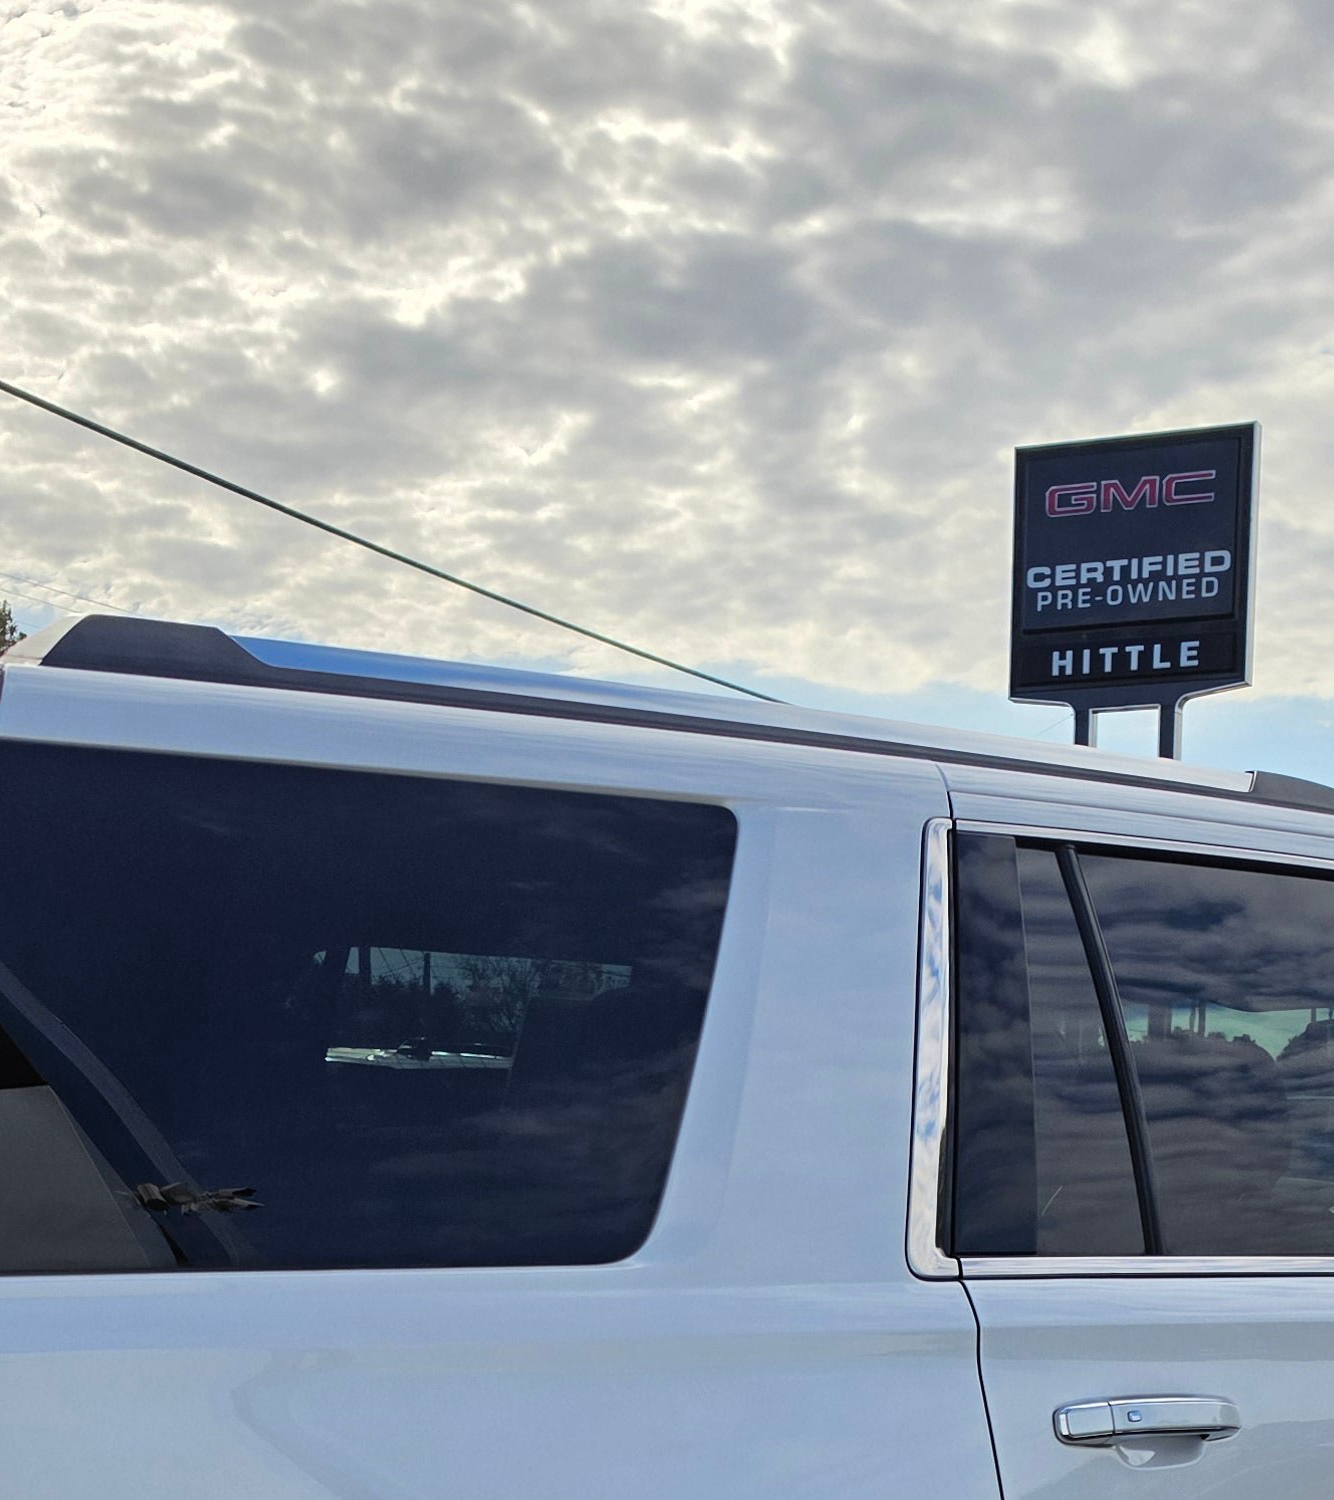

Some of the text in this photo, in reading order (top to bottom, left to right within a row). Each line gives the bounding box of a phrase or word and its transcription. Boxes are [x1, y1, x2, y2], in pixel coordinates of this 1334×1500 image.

[1045, 469, 1216, 517] GMC
[1026, 549, 1232, 588] CERTIFIED
[1036, 576, 1219, 612] PRE-OWNED
[1051, 640, 1200, 676] HITTLE
